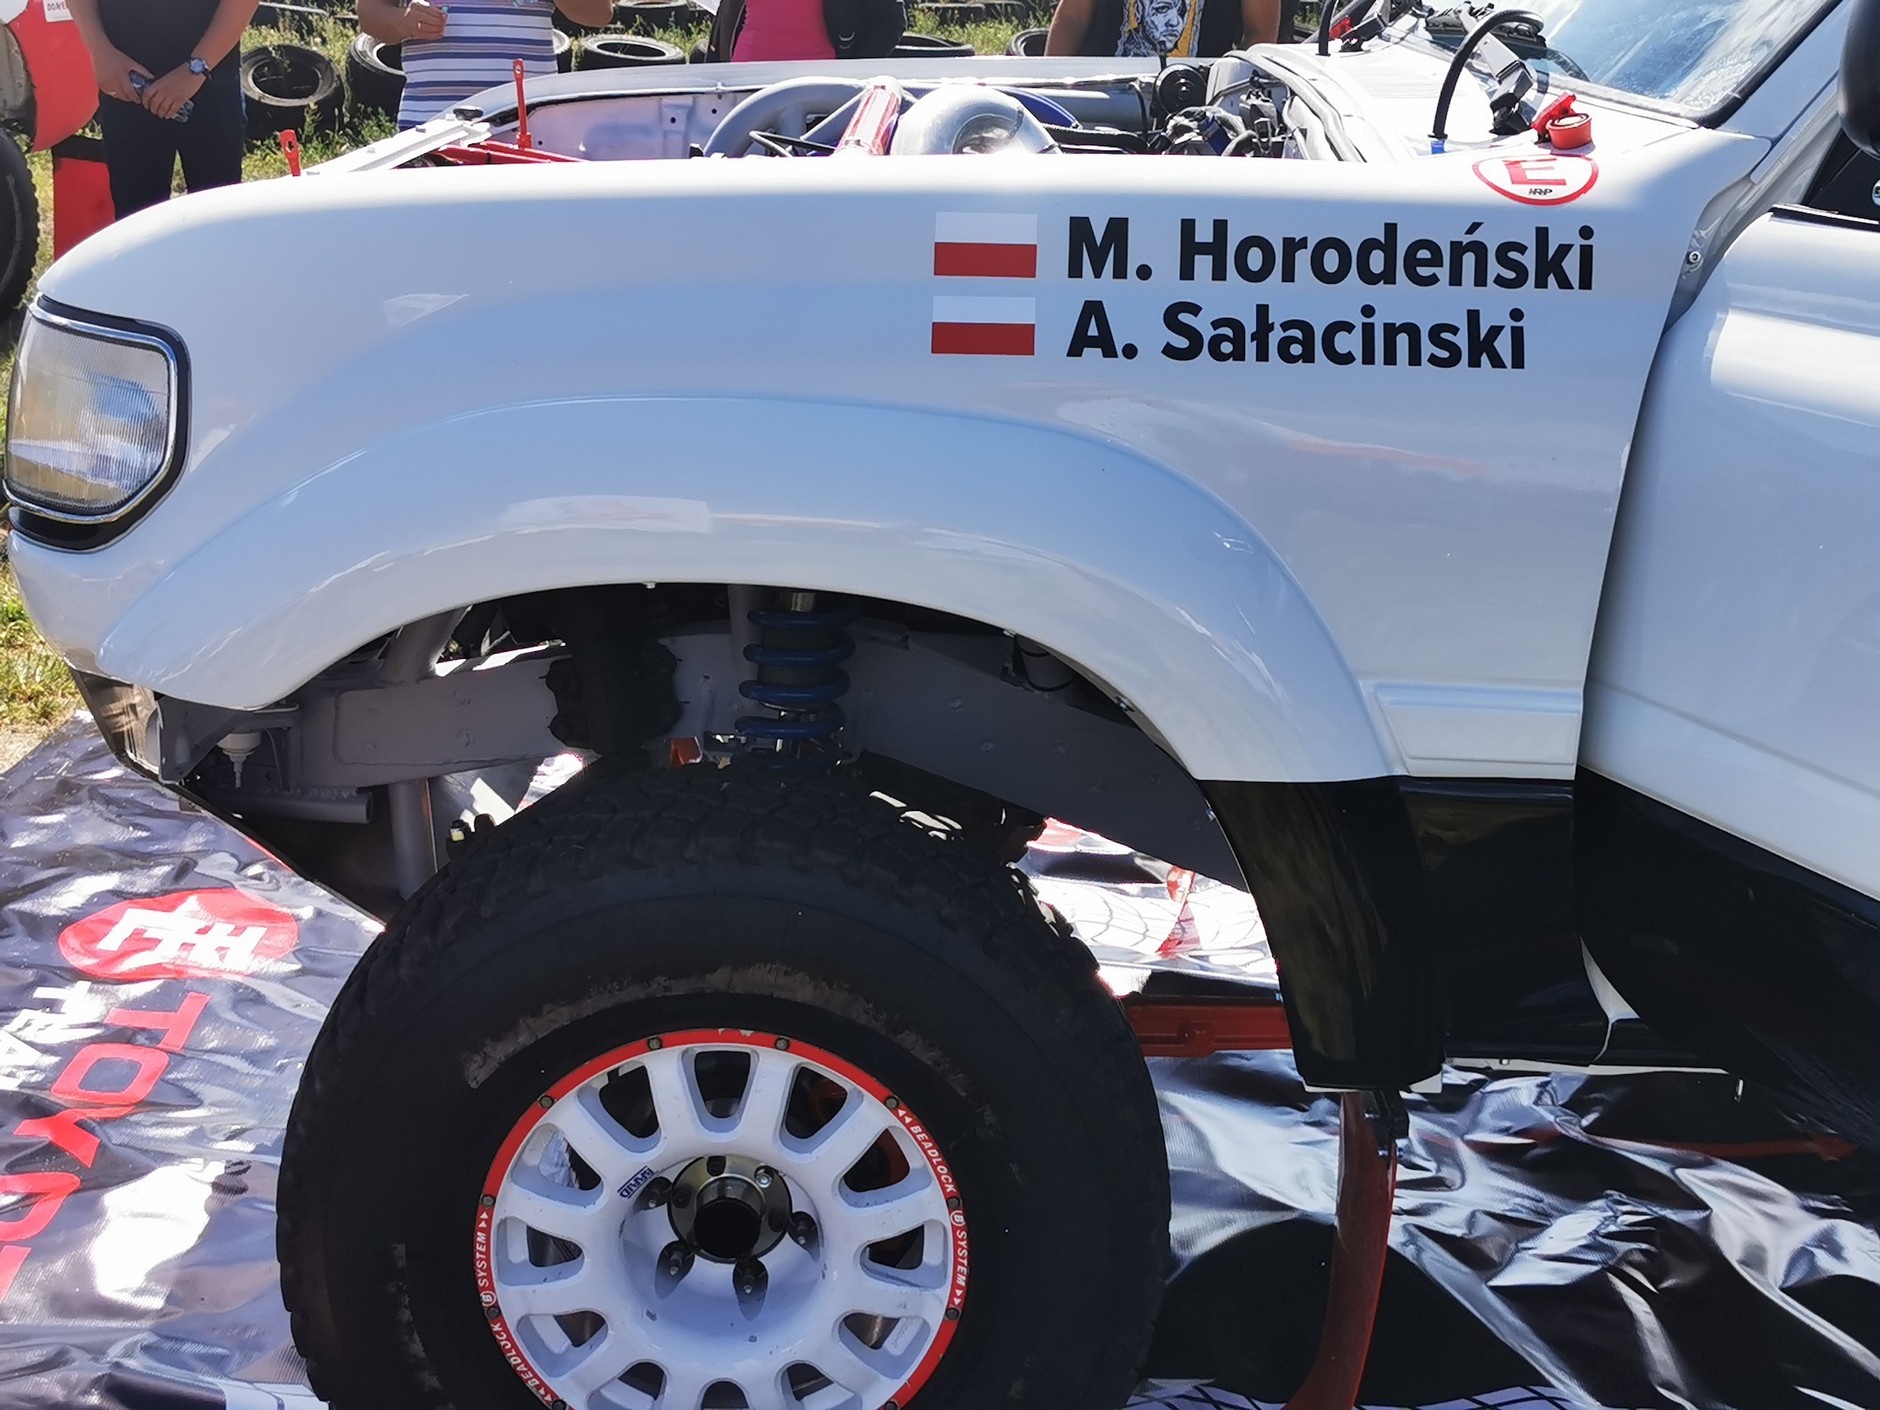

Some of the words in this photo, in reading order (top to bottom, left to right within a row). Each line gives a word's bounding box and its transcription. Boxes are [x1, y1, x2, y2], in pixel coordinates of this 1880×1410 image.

[1502, 158, 1567, 185] E
[1067, 216, 1152, 281] M.
[1179, 218, 1595, 290] Horodeński
[1066, 299, 1139, 360] A.
[1160, 301, 1526, 369] Sałacinski
[909, 1125, 957, 1193] BEADLOCK
[956, 1230, 969, 1287] SYSTEM
[475, 1231, 489, 1288] SYSTEM
[490, 1322, 539, 1388] BEADLOCK
